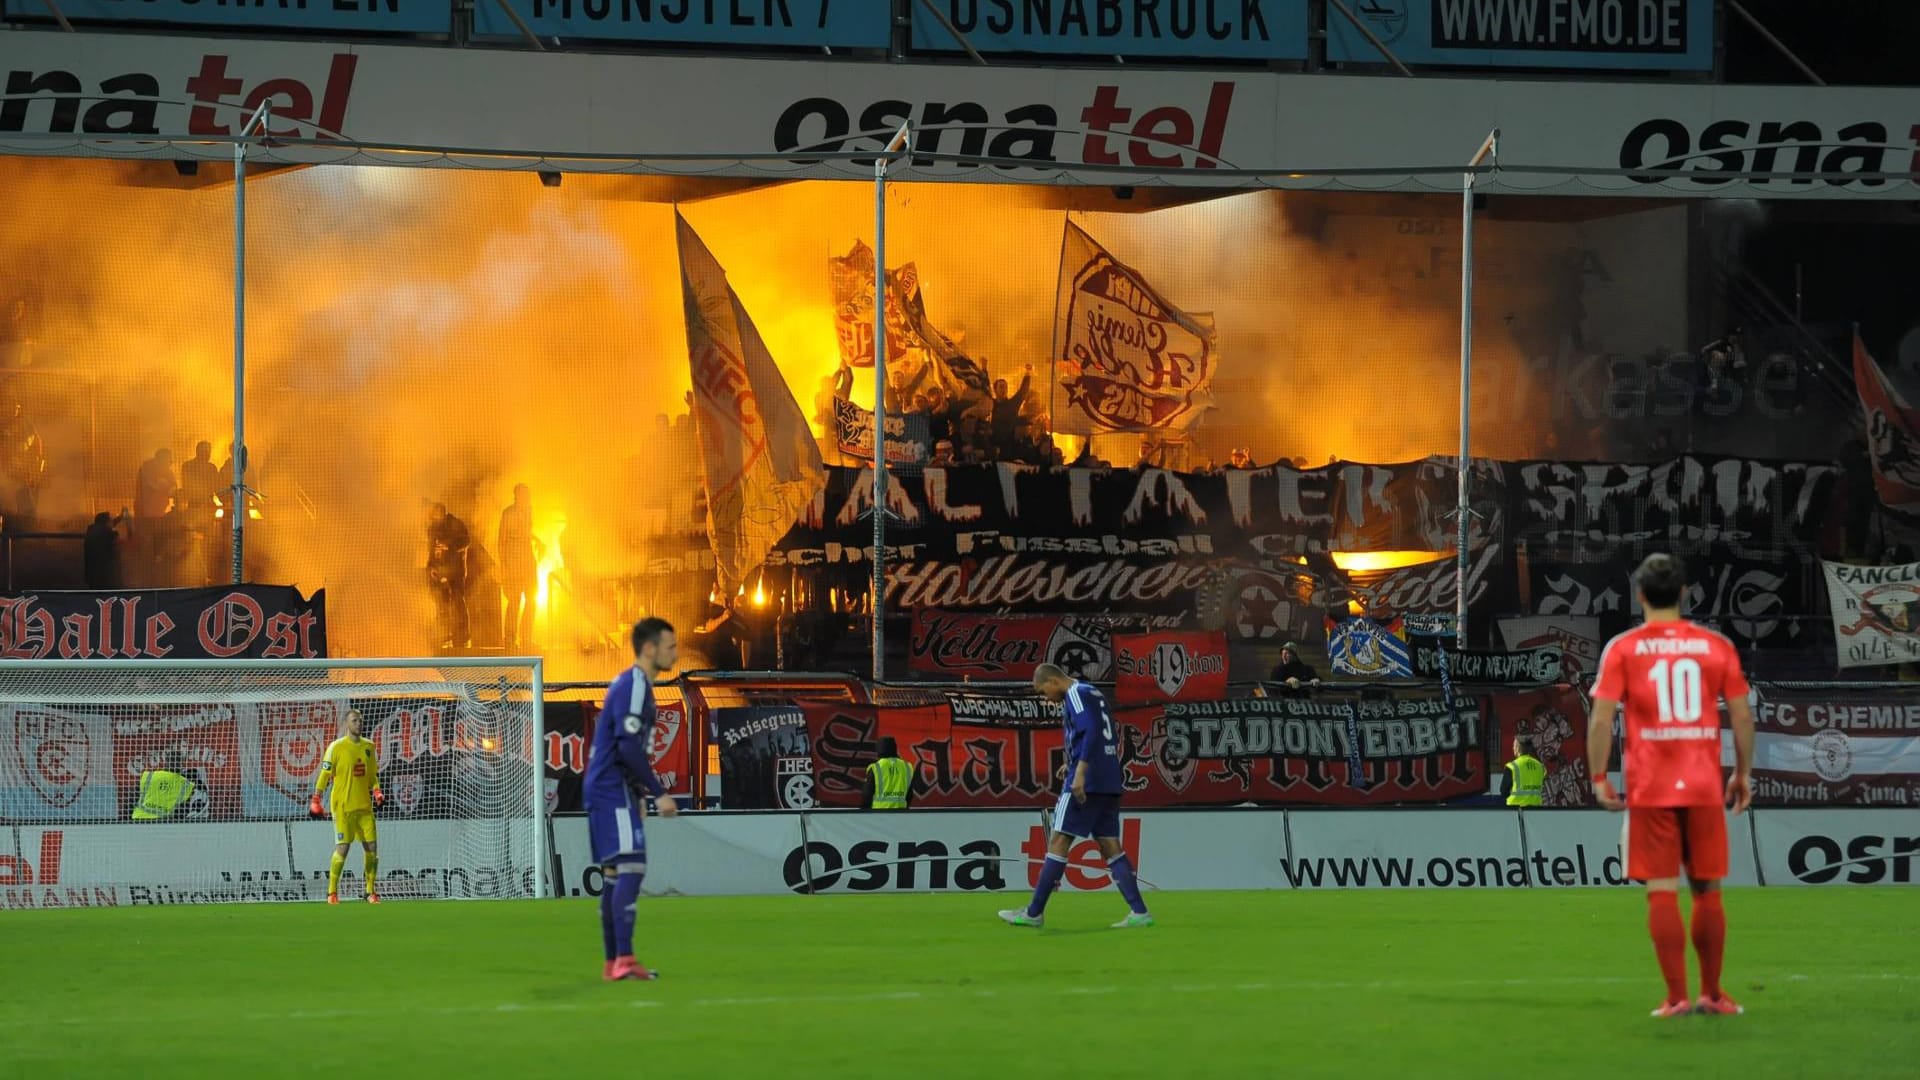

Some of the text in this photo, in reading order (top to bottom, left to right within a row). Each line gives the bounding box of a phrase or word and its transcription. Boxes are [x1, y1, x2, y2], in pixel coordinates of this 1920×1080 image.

[773, 81, 1235, 169] osnatel
[1619, 117, 1920, 186] osna
[0, 591, 318, 659] Halle Ost
[1635, 638, 1711, 655] AYDEMIR
[1648, 658, 1702, 723] 10
[0, 888, 118, 910] MANN
